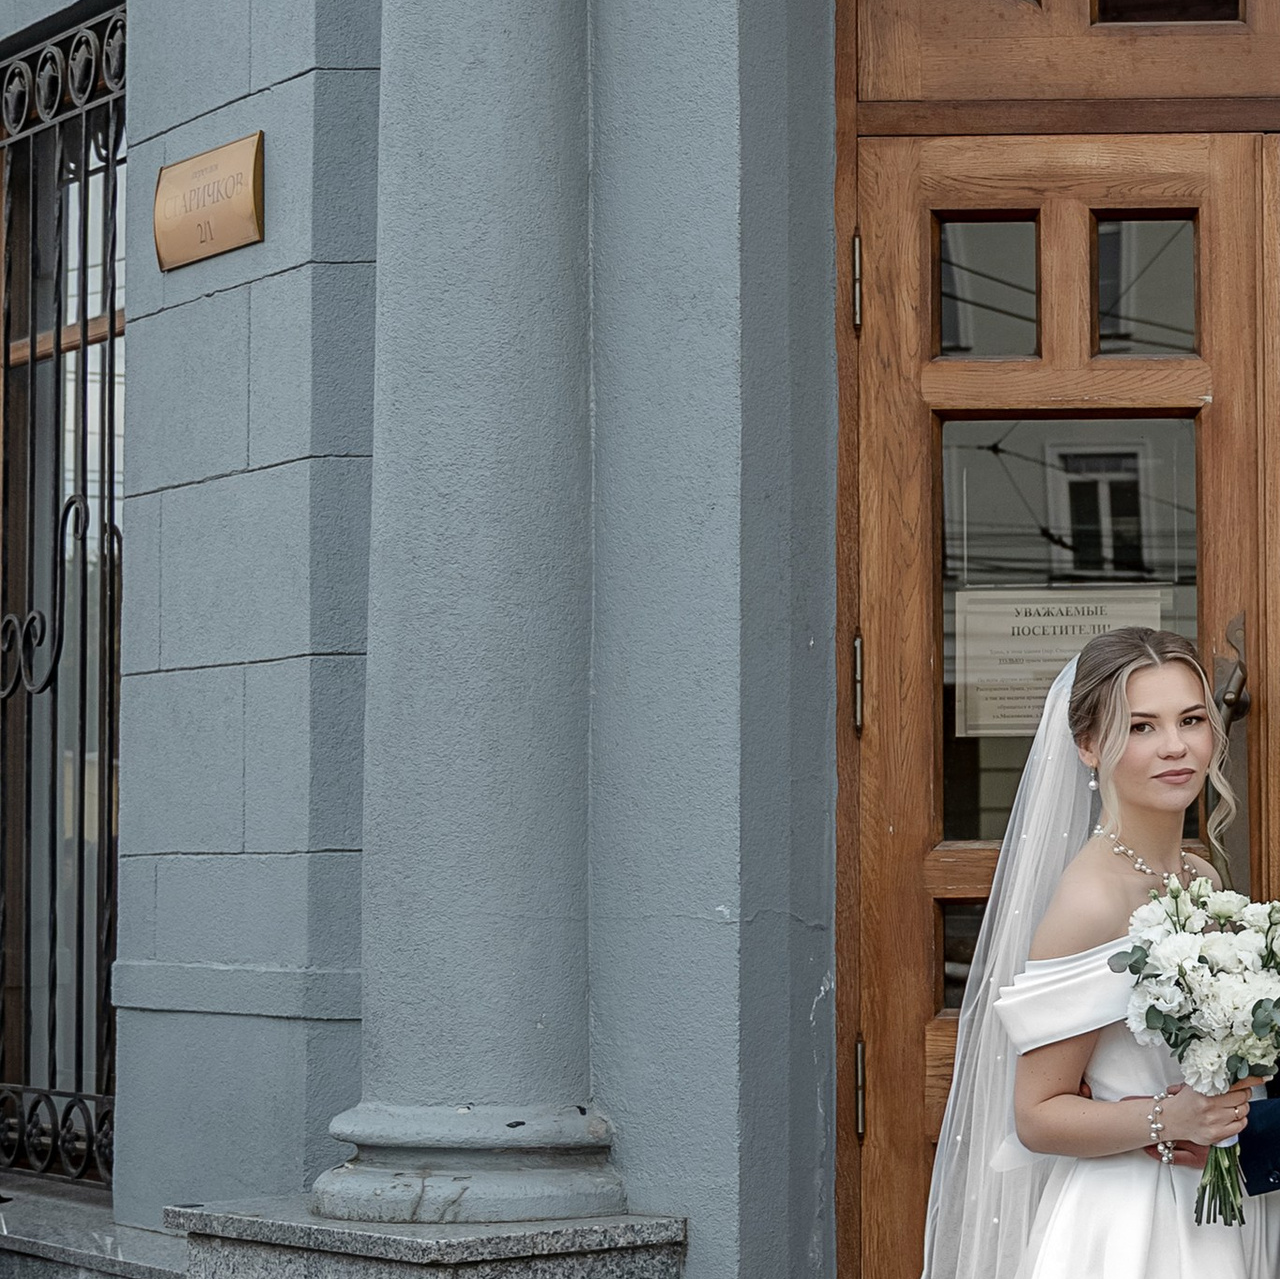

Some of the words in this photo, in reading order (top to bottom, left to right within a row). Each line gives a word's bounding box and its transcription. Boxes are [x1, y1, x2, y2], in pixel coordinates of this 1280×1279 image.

[163, 171, 244, 221] СТАРИЧКОВ
[196, 220, 215, 244] 2/1
[1014, 605, 1108, 618] УВАЖАЕМЫЕ
